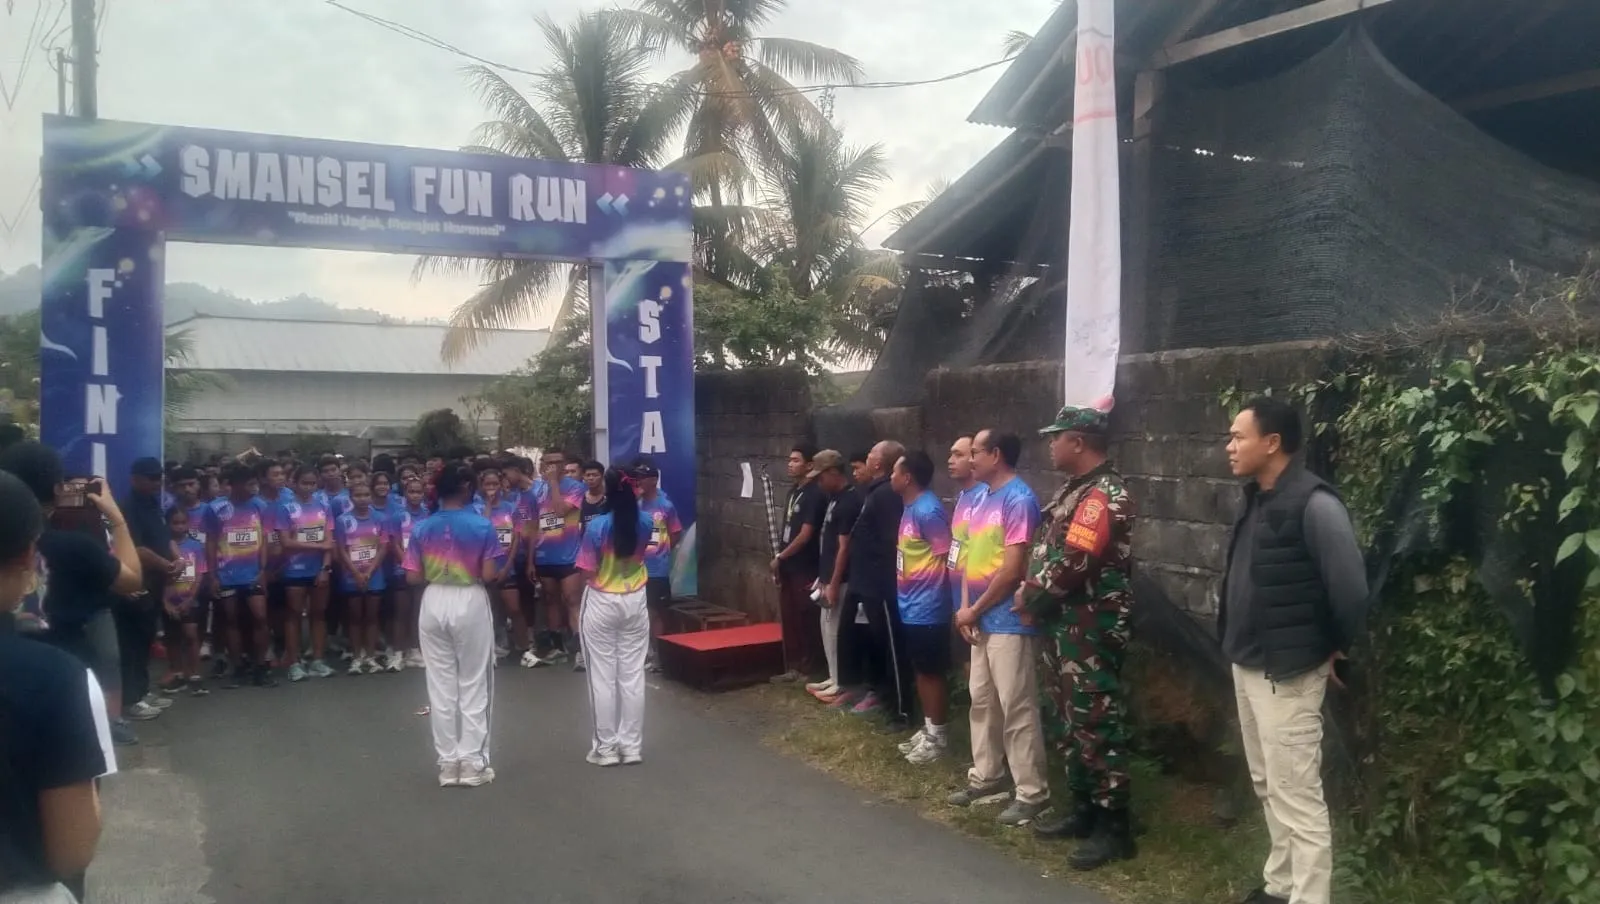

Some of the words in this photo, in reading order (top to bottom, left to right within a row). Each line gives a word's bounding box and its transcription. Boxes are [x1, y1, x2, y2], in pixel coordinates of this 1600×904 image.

[180, 144, 395, 212] SMANSEL
[411, 166, 493, 218] FUN
[509, 173, 587, 224] RUN
[639, 299, 667, 489] STA
